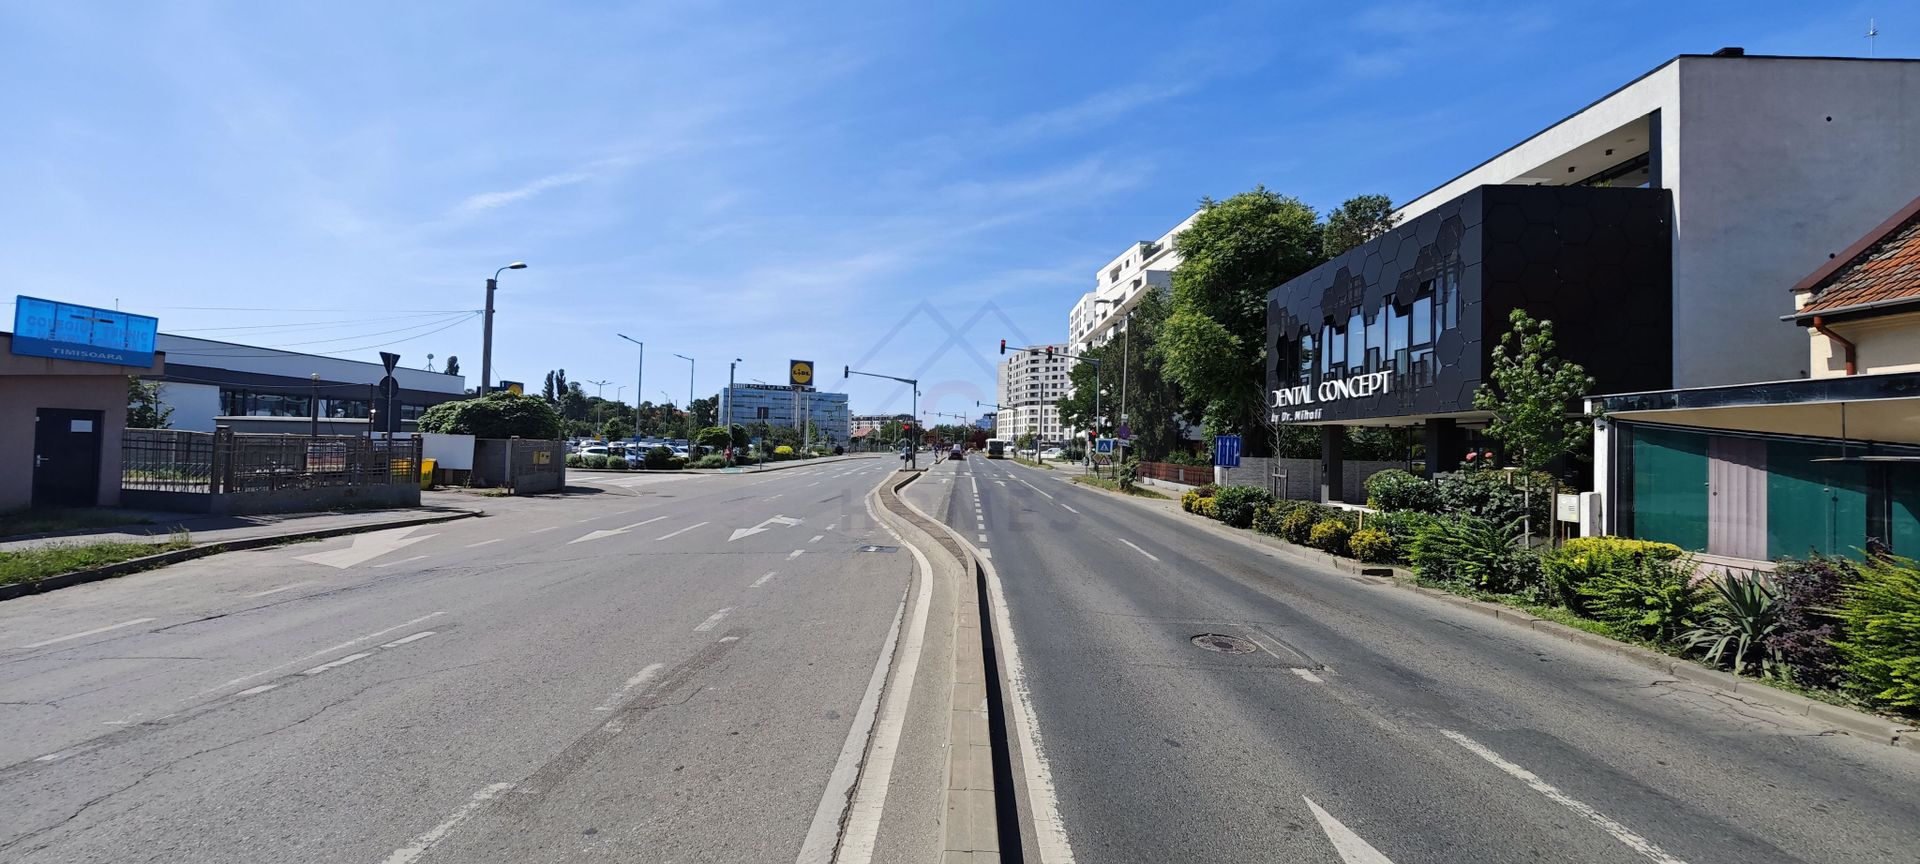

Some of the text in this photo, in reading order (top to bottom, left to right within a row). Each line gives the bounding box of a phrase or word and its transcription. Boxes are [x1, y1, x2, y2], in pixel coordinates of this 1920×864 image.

[51, 347, 124, 361] TIMISOARA
[1271, 369, 1394, 408] DENTAL CONCEPT
[1281, 411, 1294, 422] Dr.
